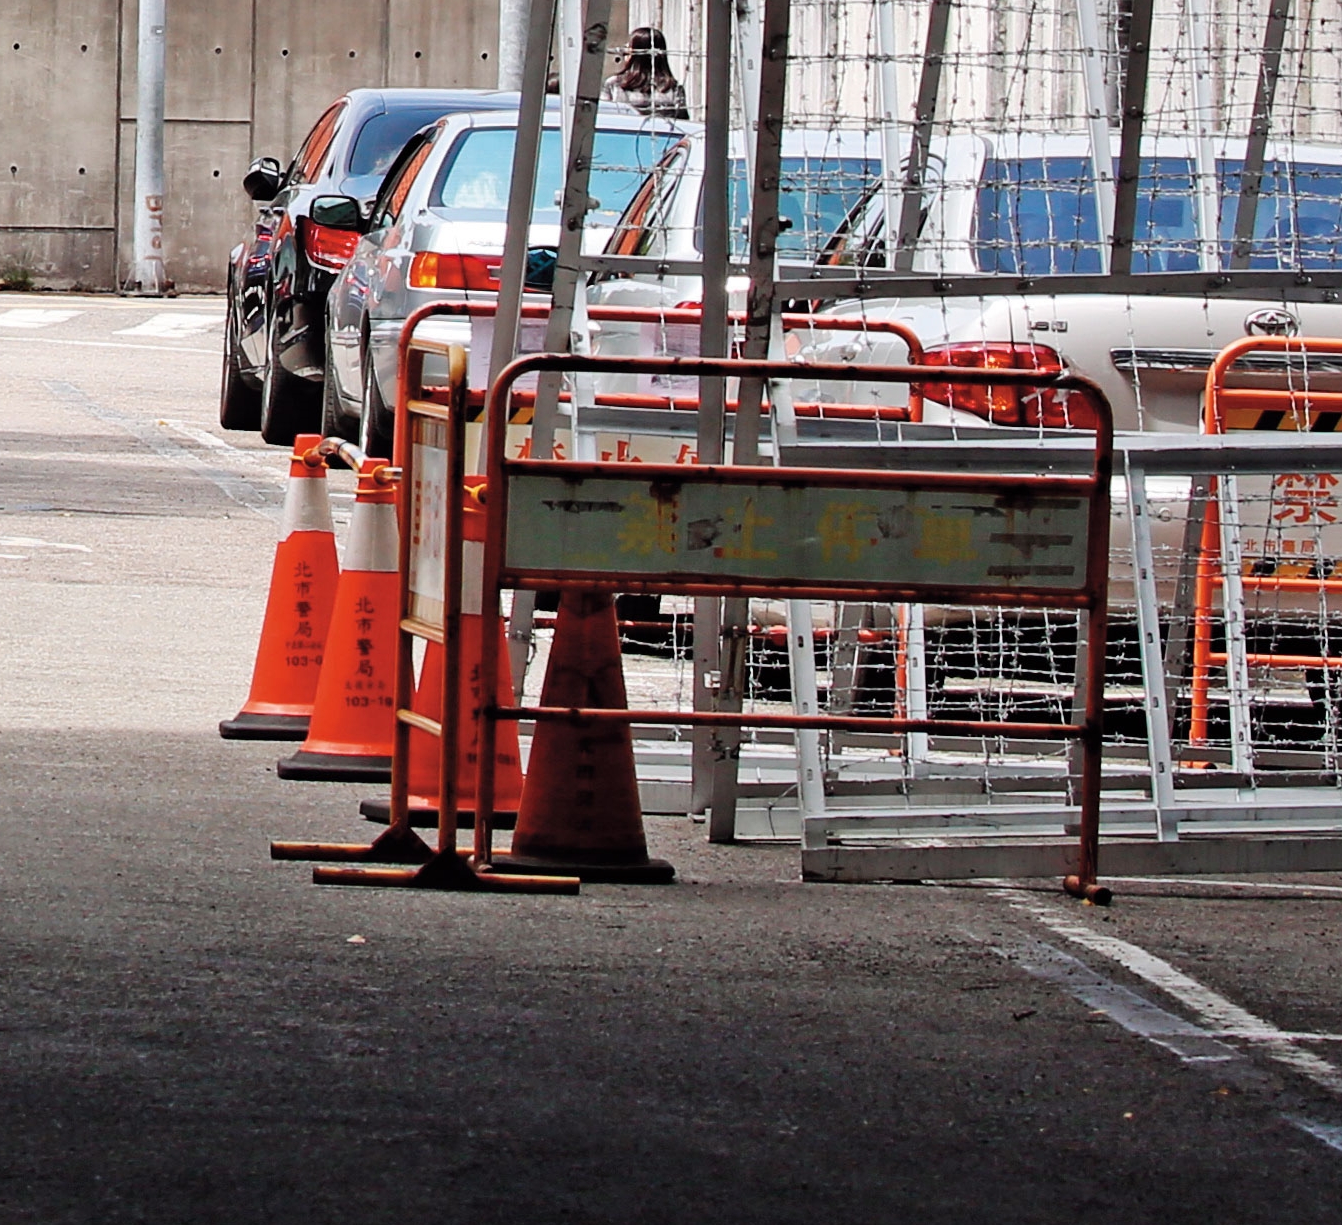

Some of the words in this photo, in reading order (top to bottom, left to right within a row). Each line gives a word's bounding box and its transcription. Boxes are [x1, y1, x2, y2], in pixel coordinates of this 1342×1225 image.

[293, 561, 313, 638] 北市警局
[354, 595, 375, 678] 北市警局
